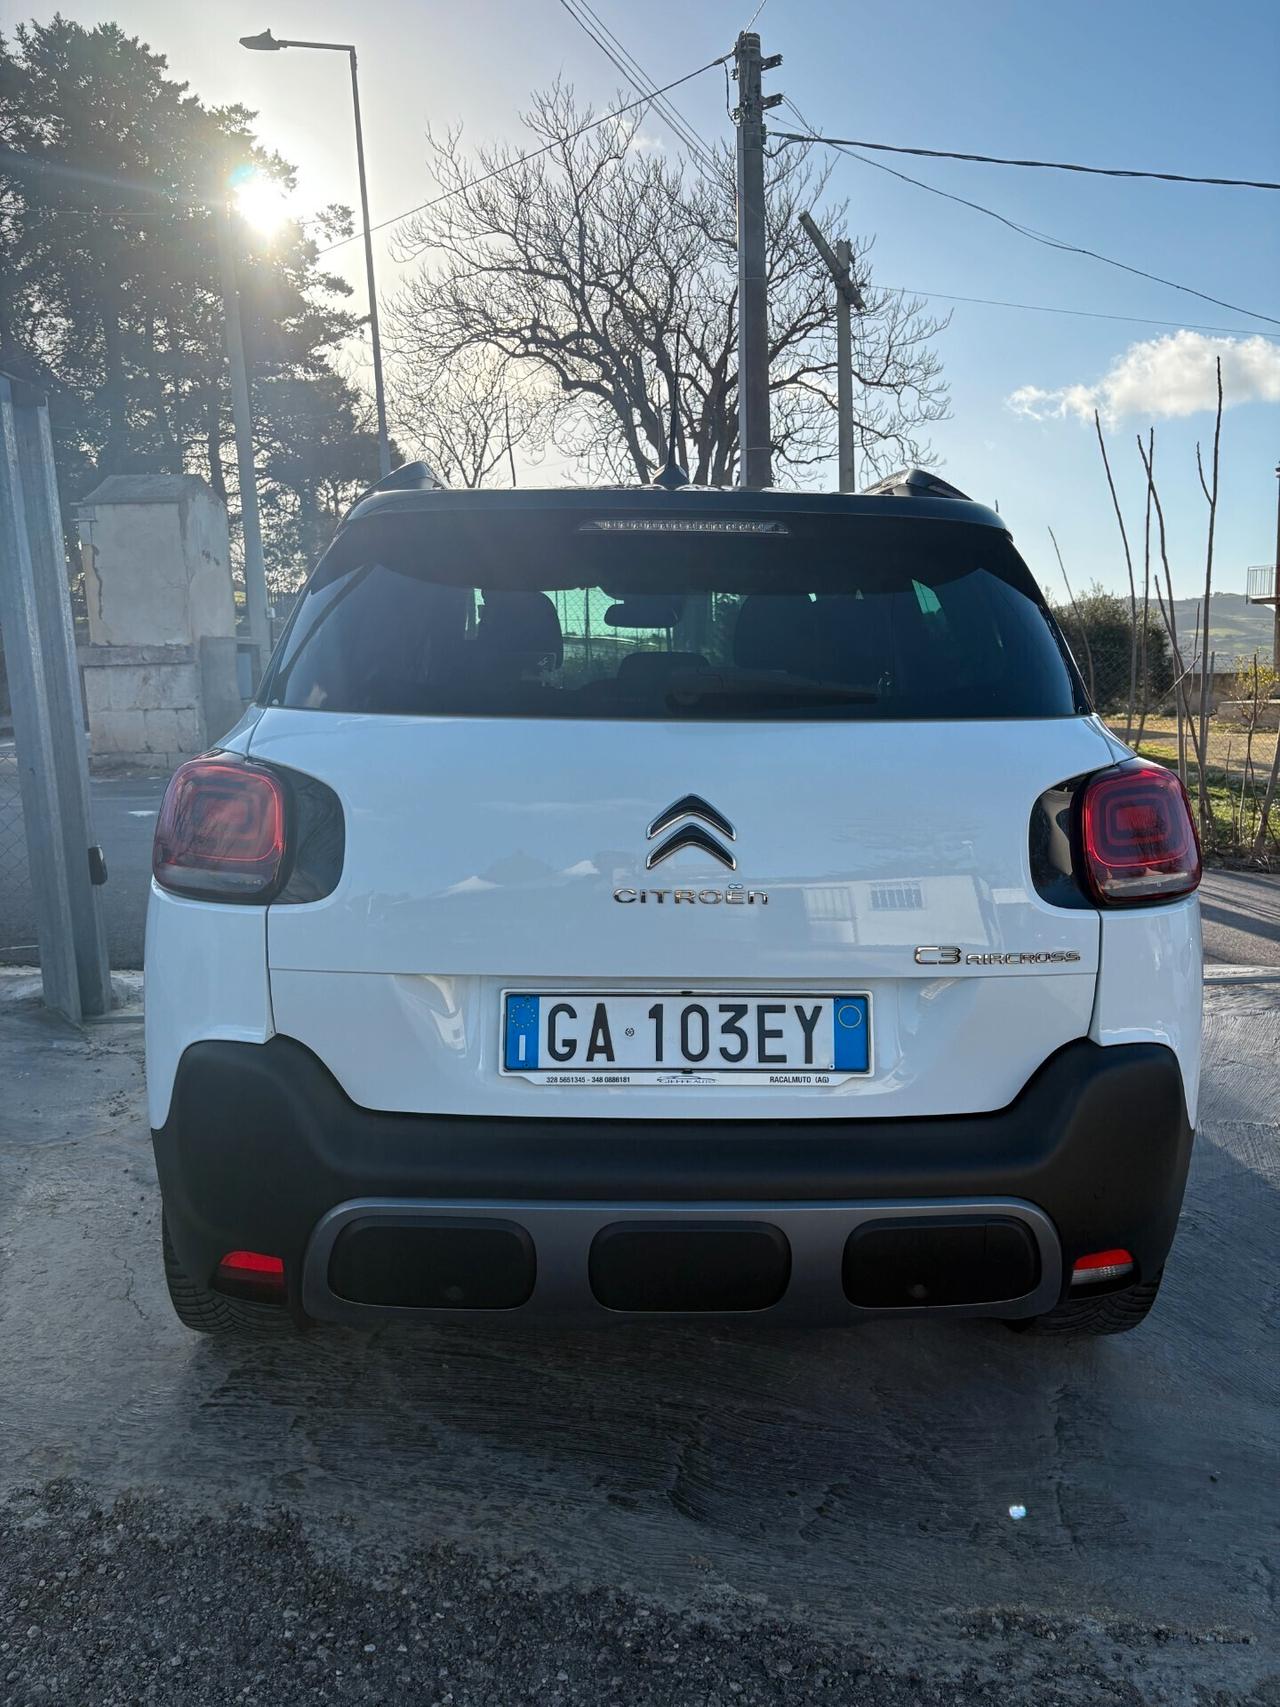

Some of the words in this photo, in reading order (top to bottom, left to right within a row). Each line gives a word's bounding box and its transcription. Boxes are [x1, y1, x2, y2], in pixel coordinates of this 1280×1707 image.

[914, 945, 962, 965] C3
[966, 951, 1081, 966] AIRCROSS
[547, 1003, 616, 1063] GA
[648, 1003, 823, 1064] 103EY
[814, 1076, 830, 1084] (AG)
